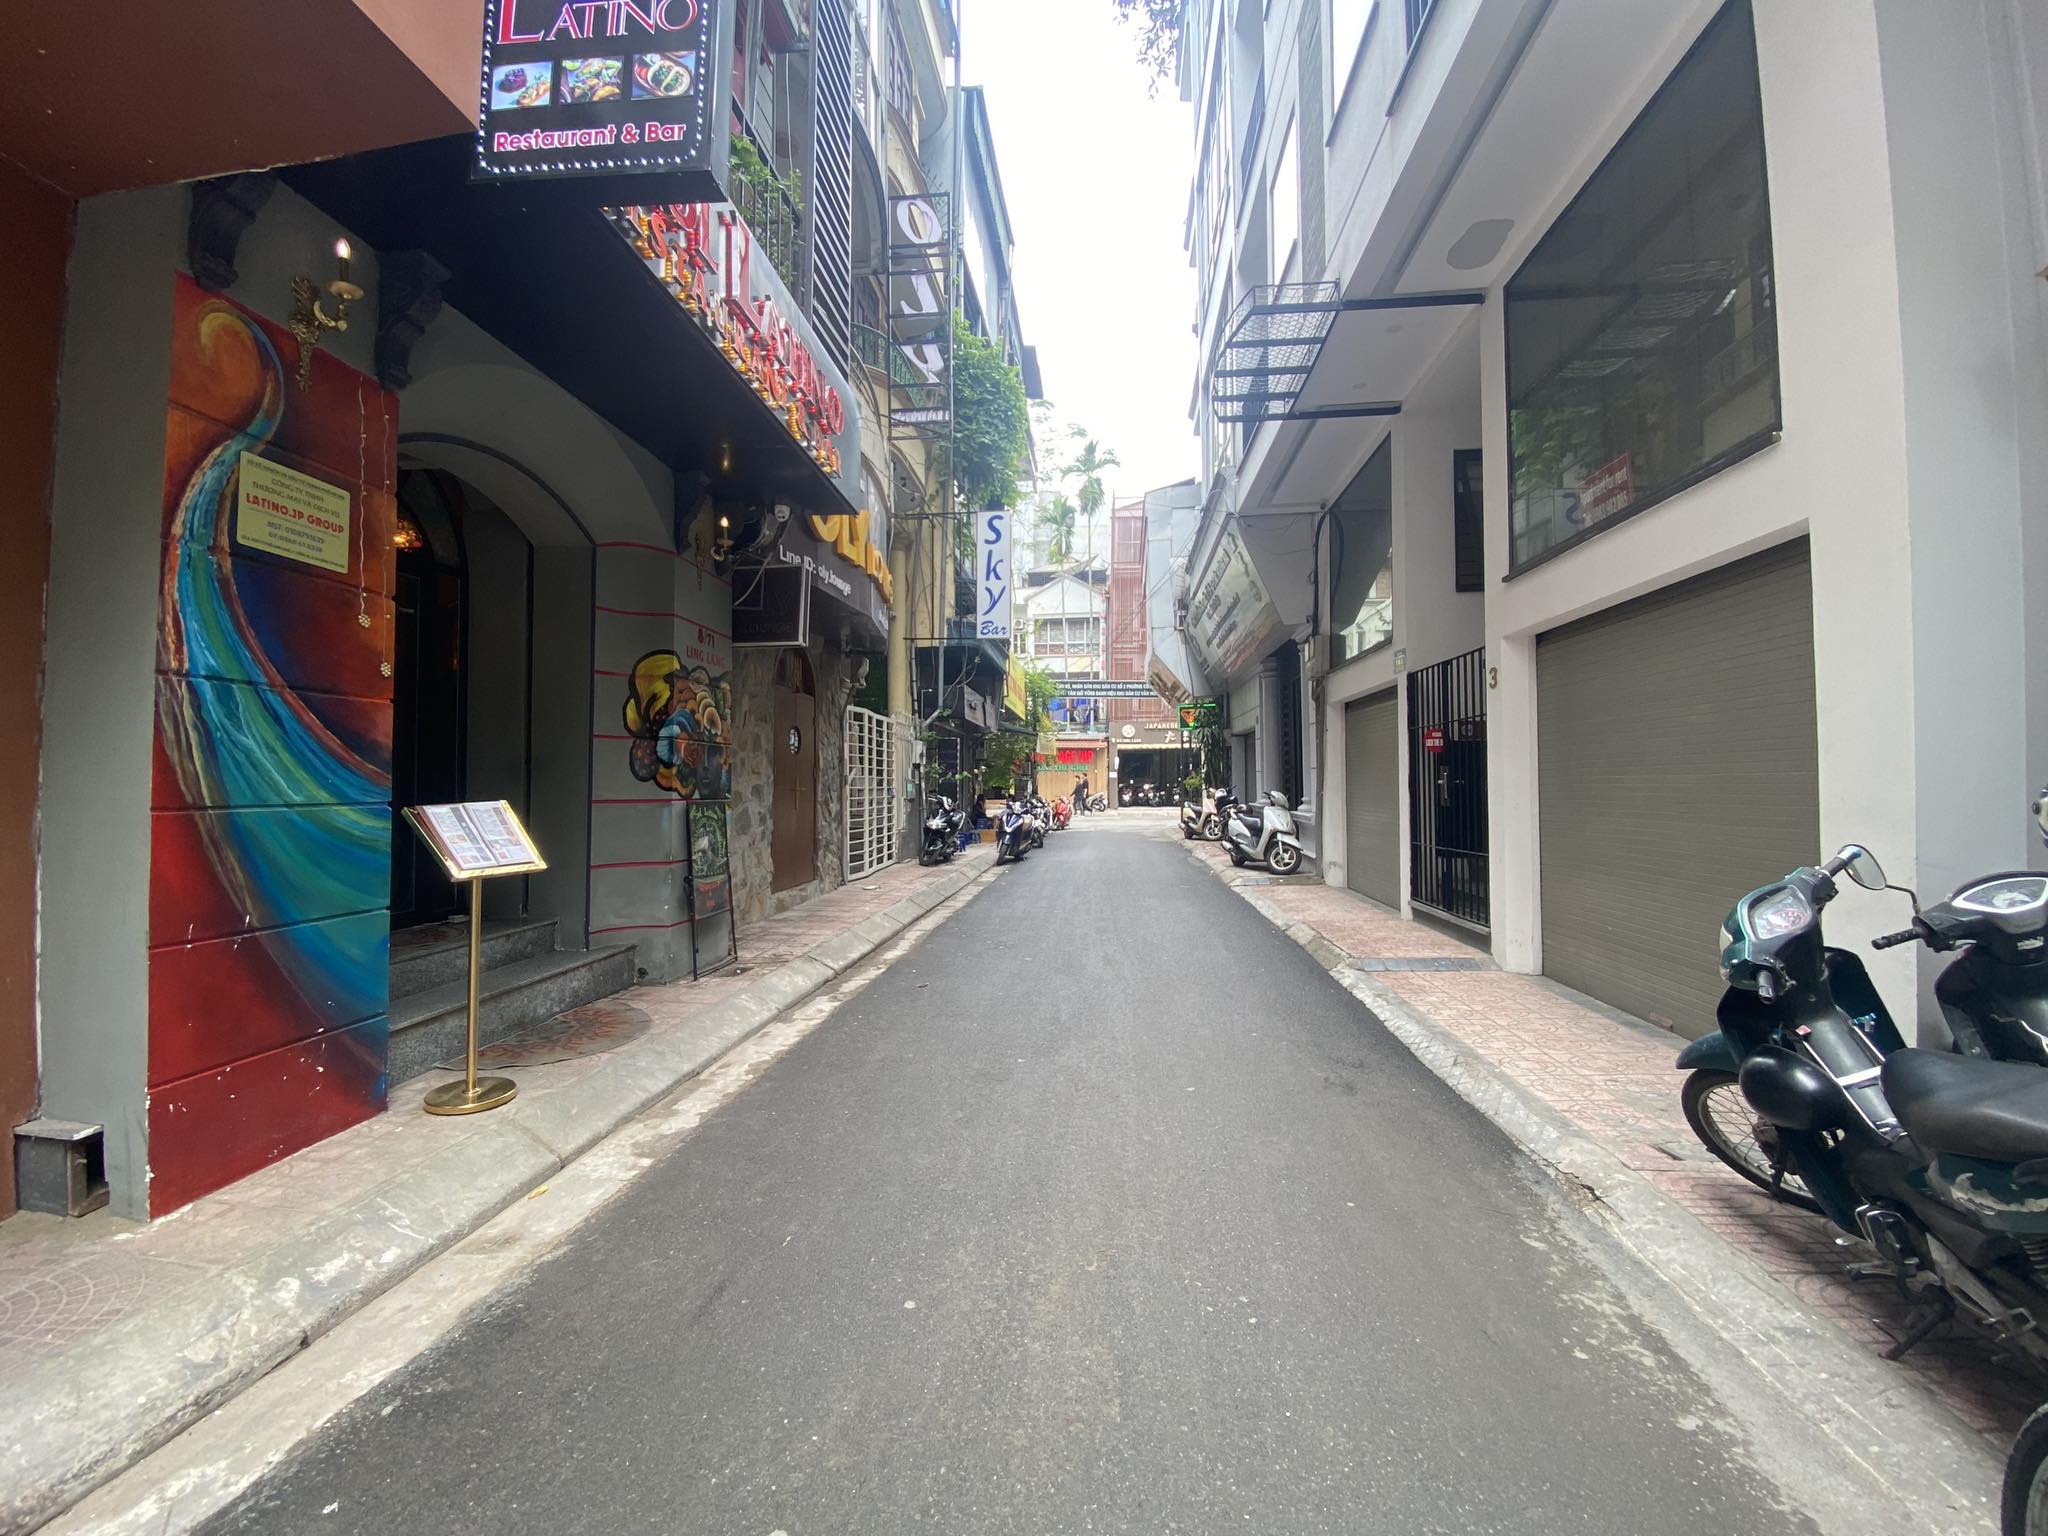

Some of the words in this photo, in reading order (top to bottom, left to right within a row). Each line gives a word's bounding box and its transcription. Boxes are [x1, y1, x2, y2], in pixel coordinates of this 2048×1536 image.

[494, 124, 616, 153] Restaurant
[622, 123, 639, 144] &
[645, 121, 687, 143] Bar
[245, 492, 304, 521] LATINO.JP
[307, 513, 345, 535] GROUP
[779, 543, 801, 565] Line
[979, 620, 1009, 637] Bar
[1488, 666, 1498, 690] 3
